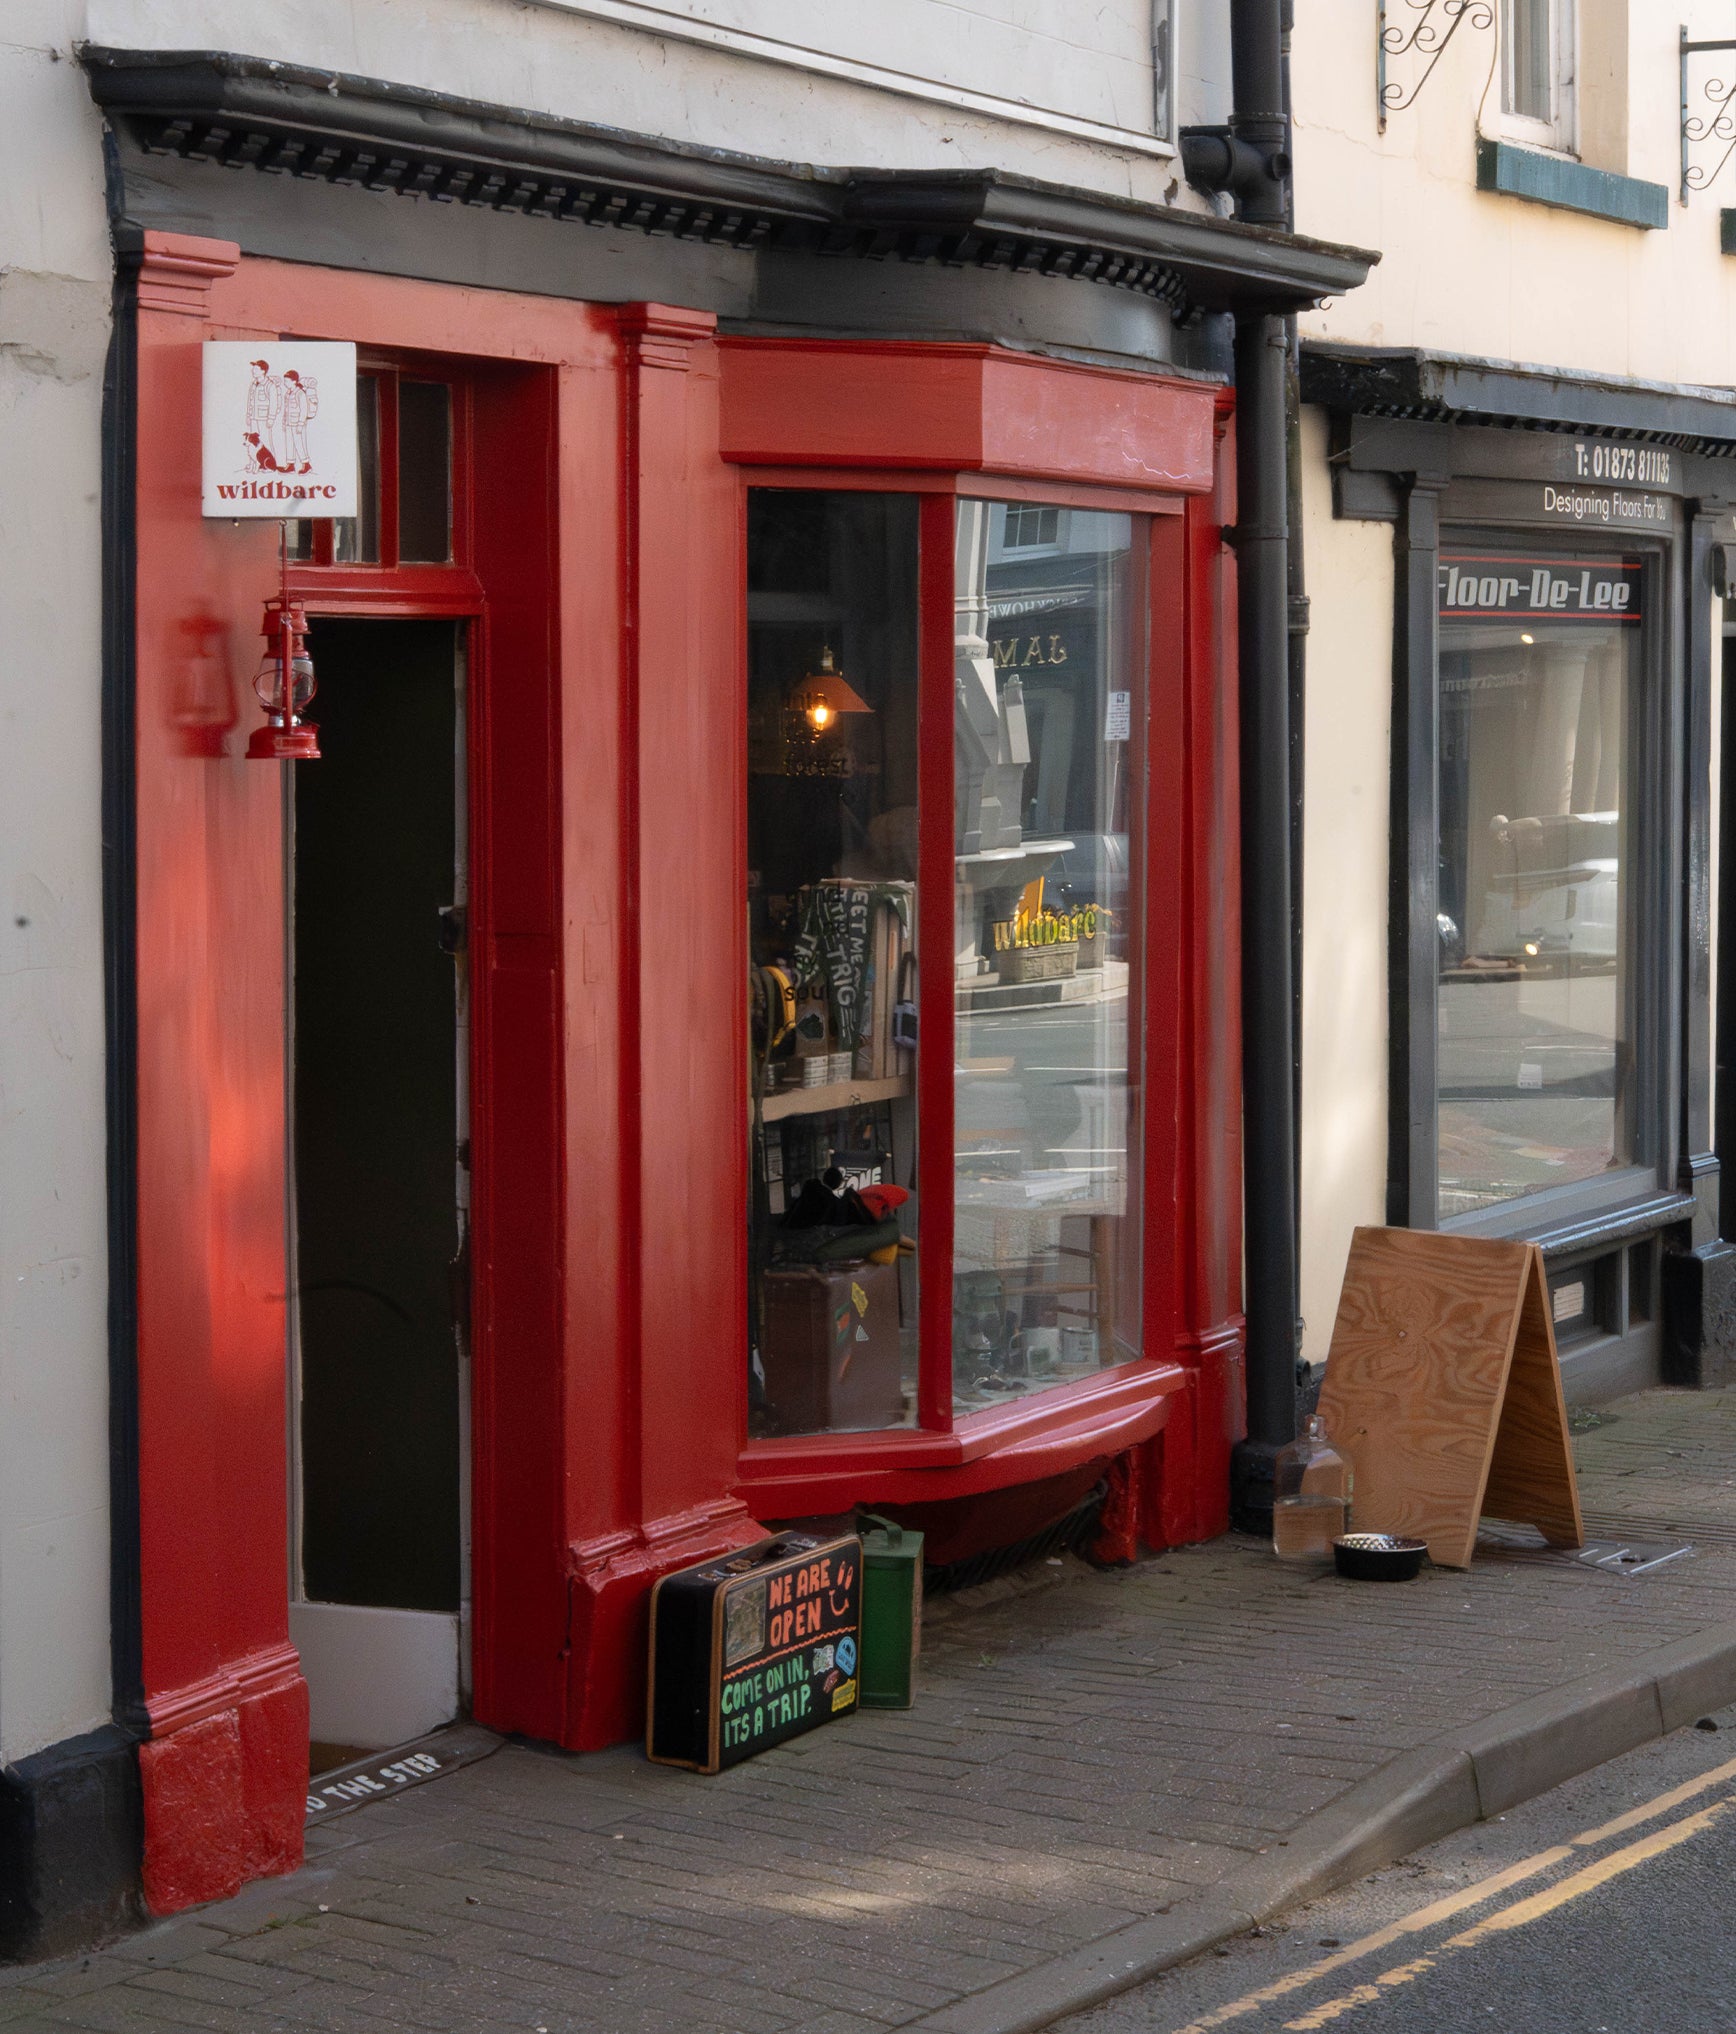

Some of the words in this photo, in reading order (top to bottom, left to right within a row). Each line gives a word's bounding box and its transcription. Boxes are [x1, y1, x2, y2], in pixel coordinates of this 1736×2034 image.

[1575, 444, 1588, 477] T:
[1593, 445, 1635, 481] 01873
[216, 480, 337, 499] wildbarc
[1544, 487, 1610, 521] Designing
[1613, 492, 1642, 518] Floors
[1643, 495, 1656, 519] For
[850, 888, 869, 934] EET
[826, 943, 857, 1007] TRIG
[769, 1574, 792, 1610] WE
[796, 1558, 831, 1599] ARE
[769, 1598, 822, 1648] OPEN
[721, 1675, 763, 1715] COME
[766, 1668, 784, 1693] ON
[787, 1654, 809, 1685] IN,
[724, 1714, 750, 1748] ITS
[753, 1707, 764, 1736] A
[767, 1684, 812, 1729] TRIP.
[322, 1774, 386, 1800] THE
[379, 1753, 442, 1783] STEP
